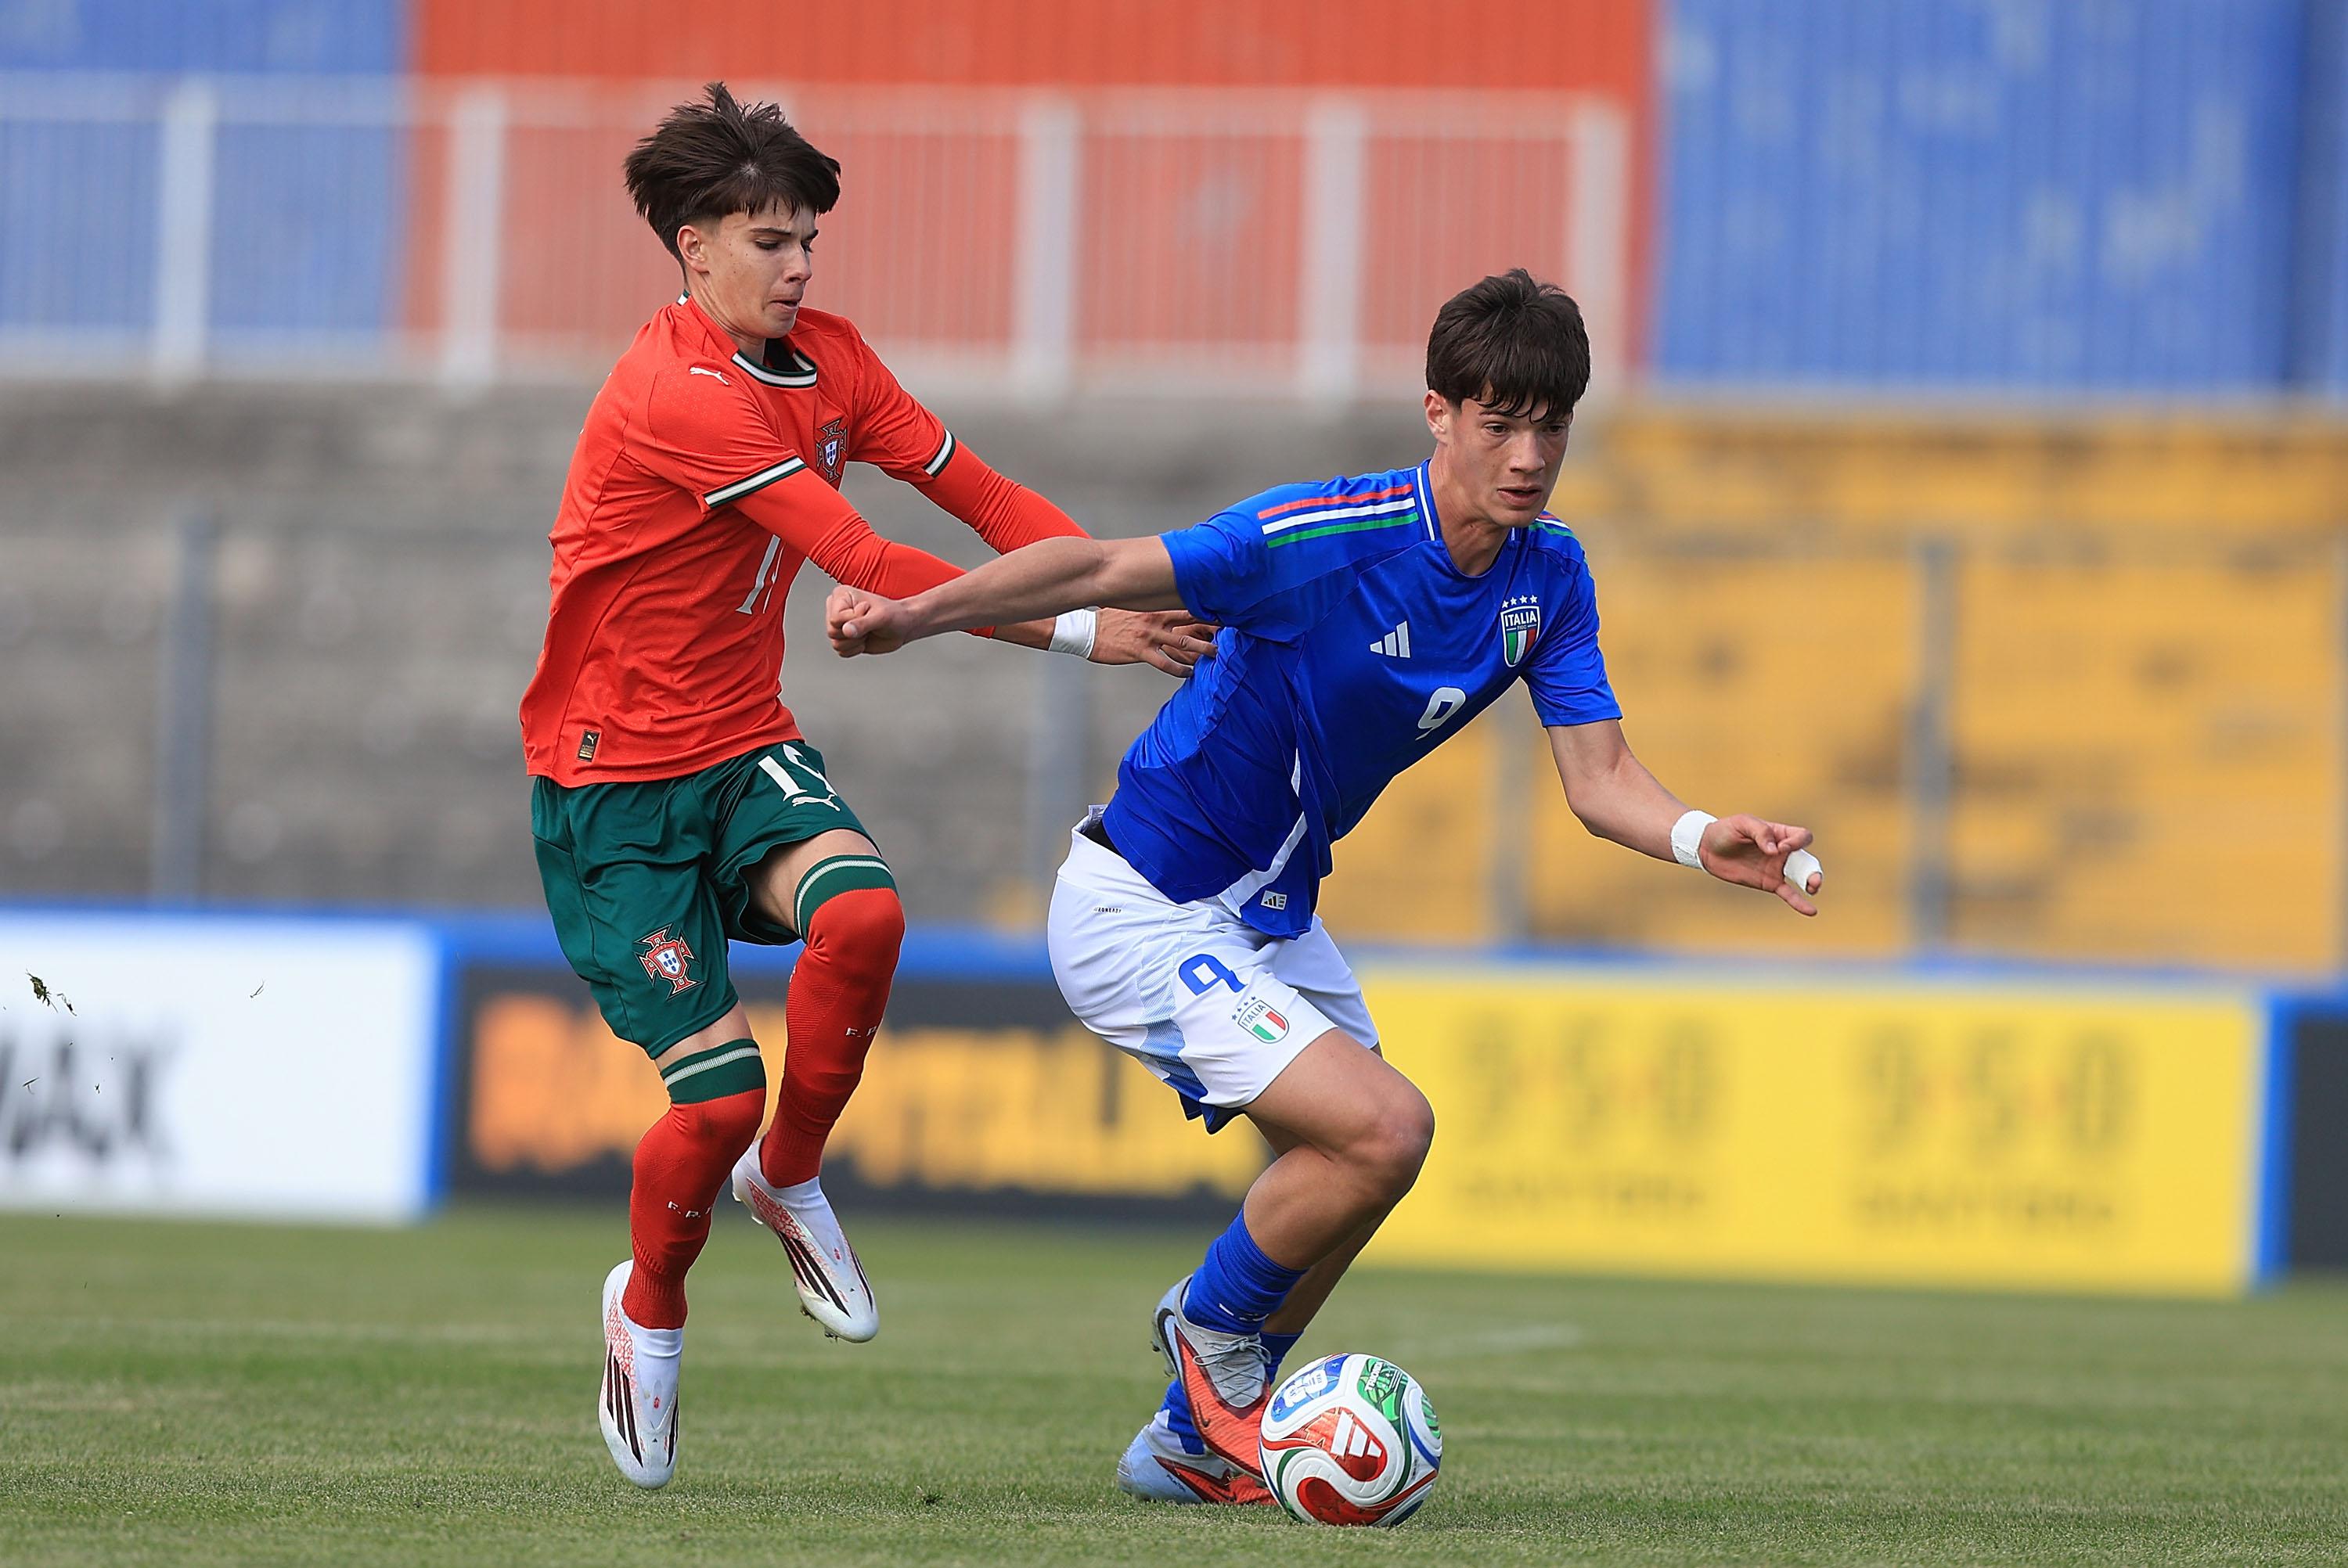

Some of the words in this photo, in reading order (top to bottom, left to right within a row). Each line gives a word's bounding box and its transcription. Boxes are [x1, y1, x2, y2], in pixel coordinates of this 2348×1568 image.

[736, 534, 785, 614] 1
[1504, 610, 1537, 627] ITALIA
[1415, 687, 1466, 741] 9
[1179, 954, 1247, 995] 9
[1241, 1004, 1266, 1027] ITALIA
